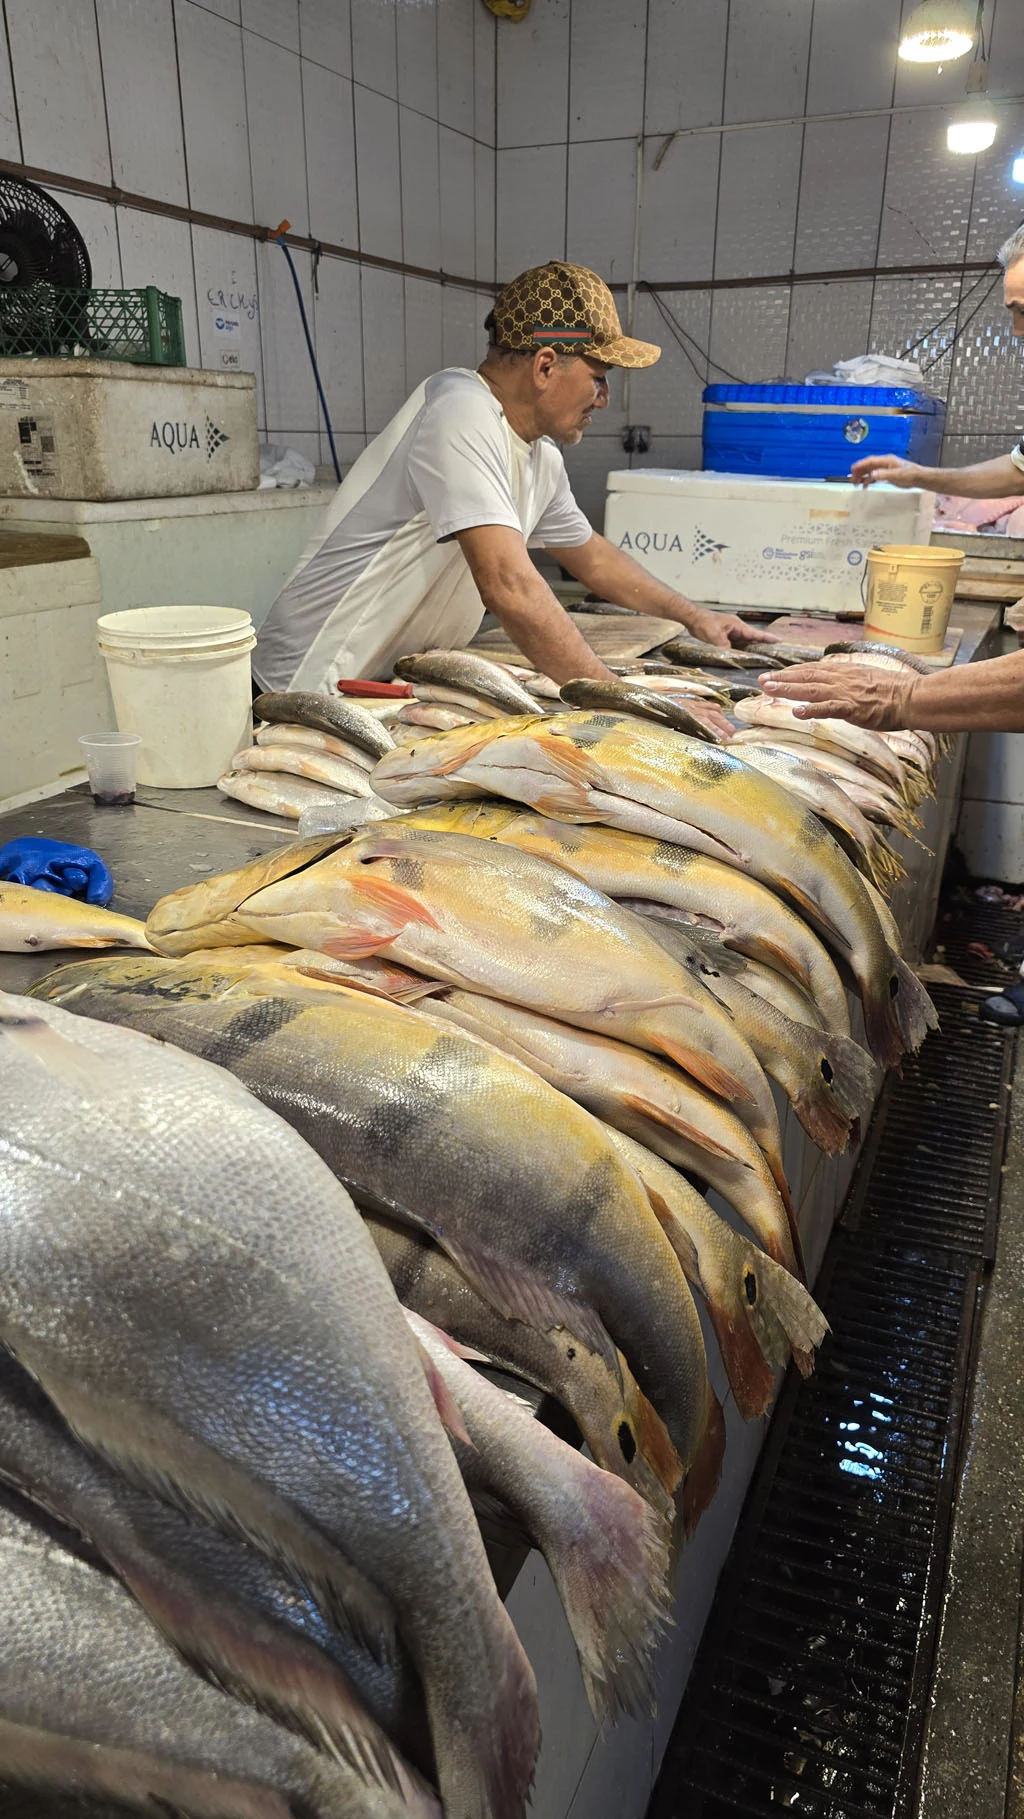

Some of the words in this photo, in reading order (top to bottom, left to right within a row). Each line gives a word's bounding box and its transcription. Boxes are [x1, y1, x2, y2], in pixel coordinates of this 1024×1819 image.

[150, 420, 200, 455] AQUA
[618, 531, 683, 555] AQUA
[780, 533, 823, 545] Premium
